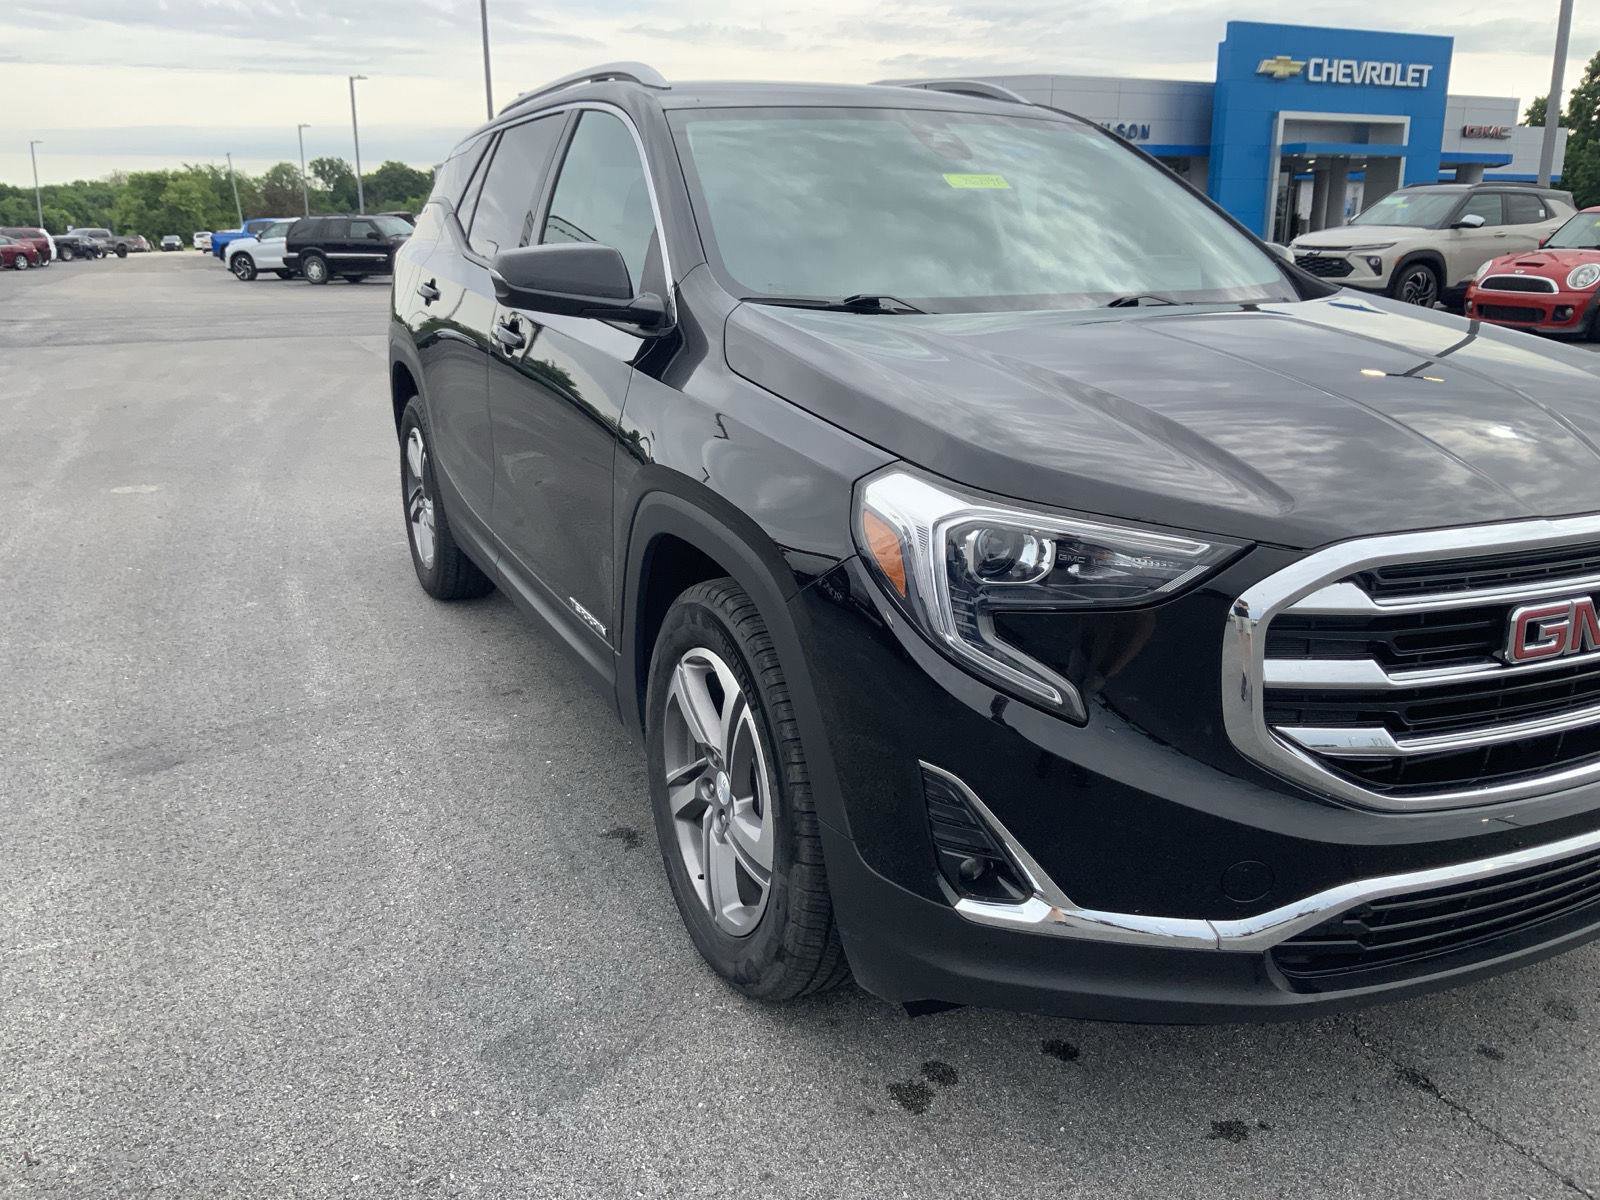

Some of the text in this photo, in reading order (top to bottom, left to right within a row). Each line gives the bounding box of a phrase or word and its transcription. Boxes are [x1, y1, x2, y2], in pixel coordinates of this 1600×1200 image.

[1308, 58, 1433, 88] CHEVROLET
[1462, 124, 1512, 139] GMC
[1058, 554, 1086, 564] GMC
